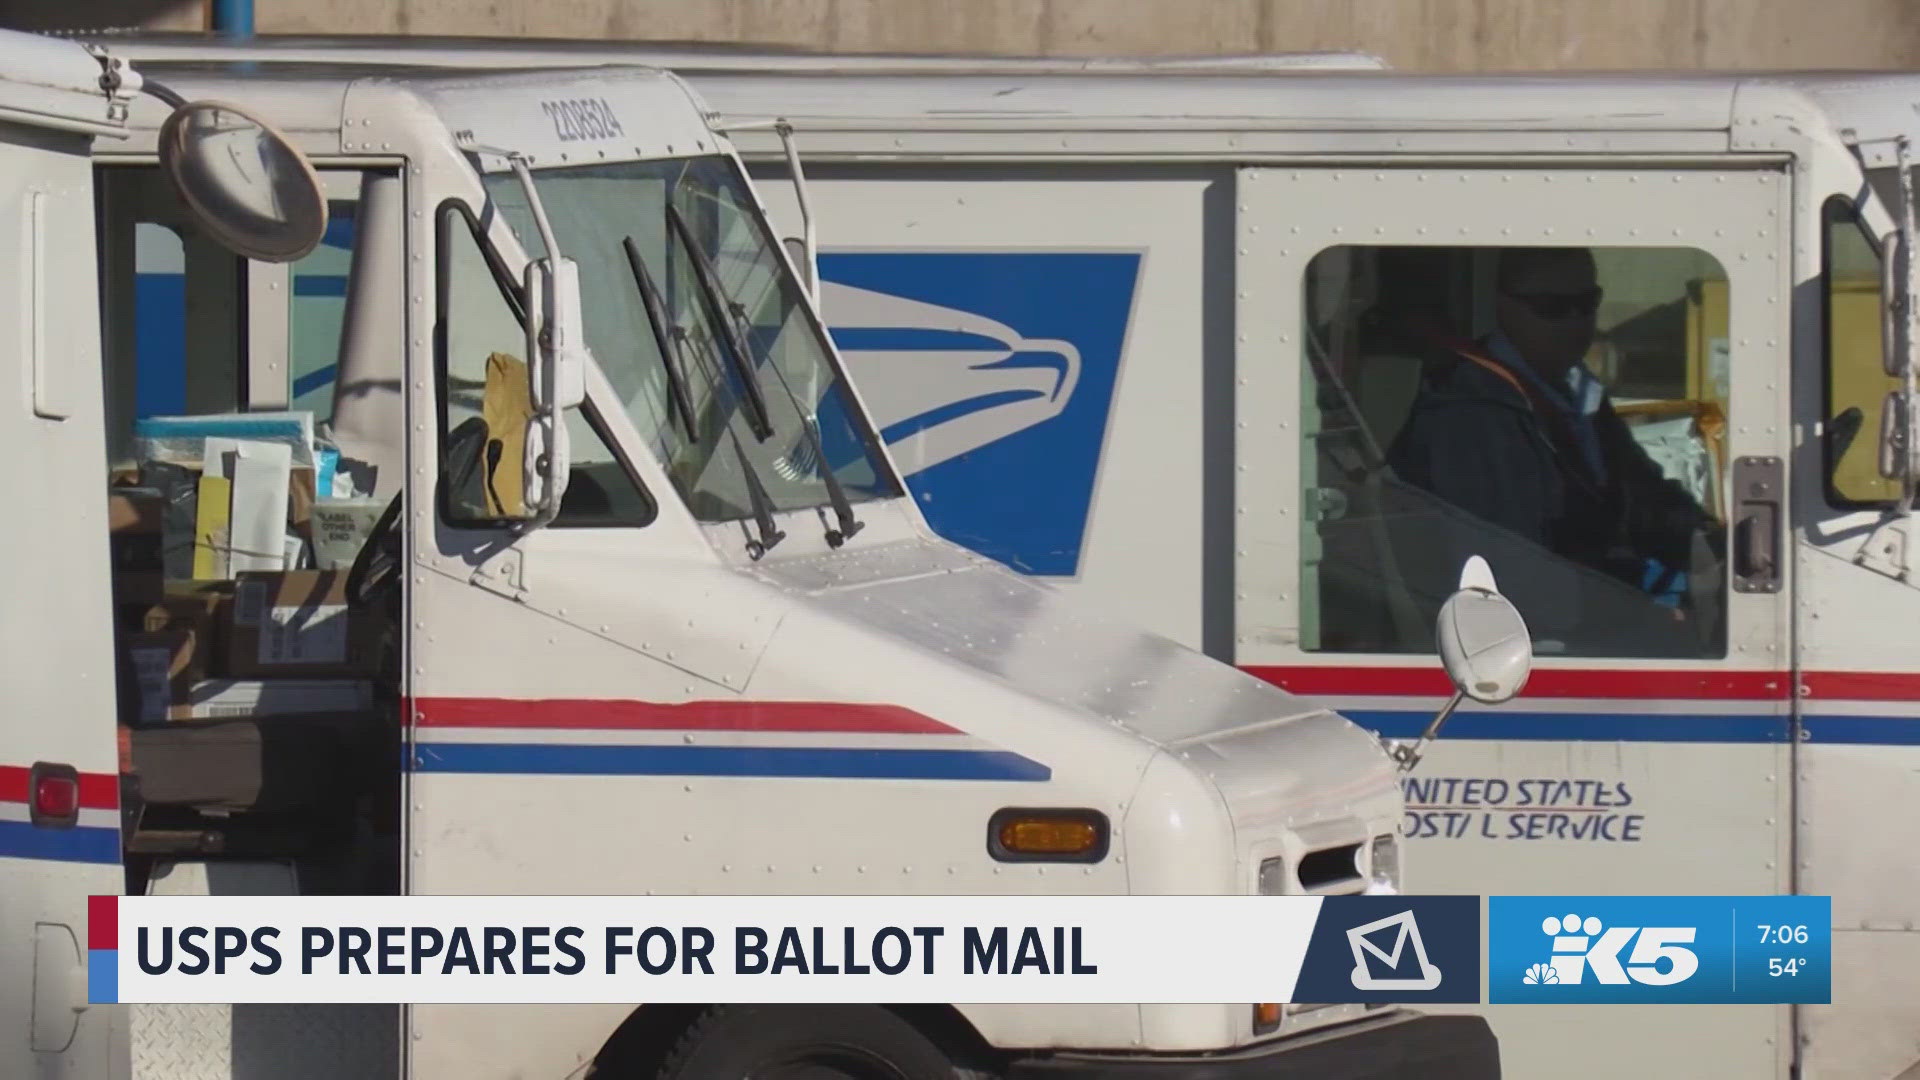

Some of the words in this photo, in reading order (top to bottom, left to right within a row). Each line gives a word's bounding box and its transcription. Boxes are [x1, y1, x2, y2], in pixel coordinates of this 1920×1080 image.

[321, 522, 356, 532] OTHER
[1401, 778, 1509, 805] NITED
[1516, 778, 1633, 807] STATES
[1506, 813, 1645, 842] SERVICE
